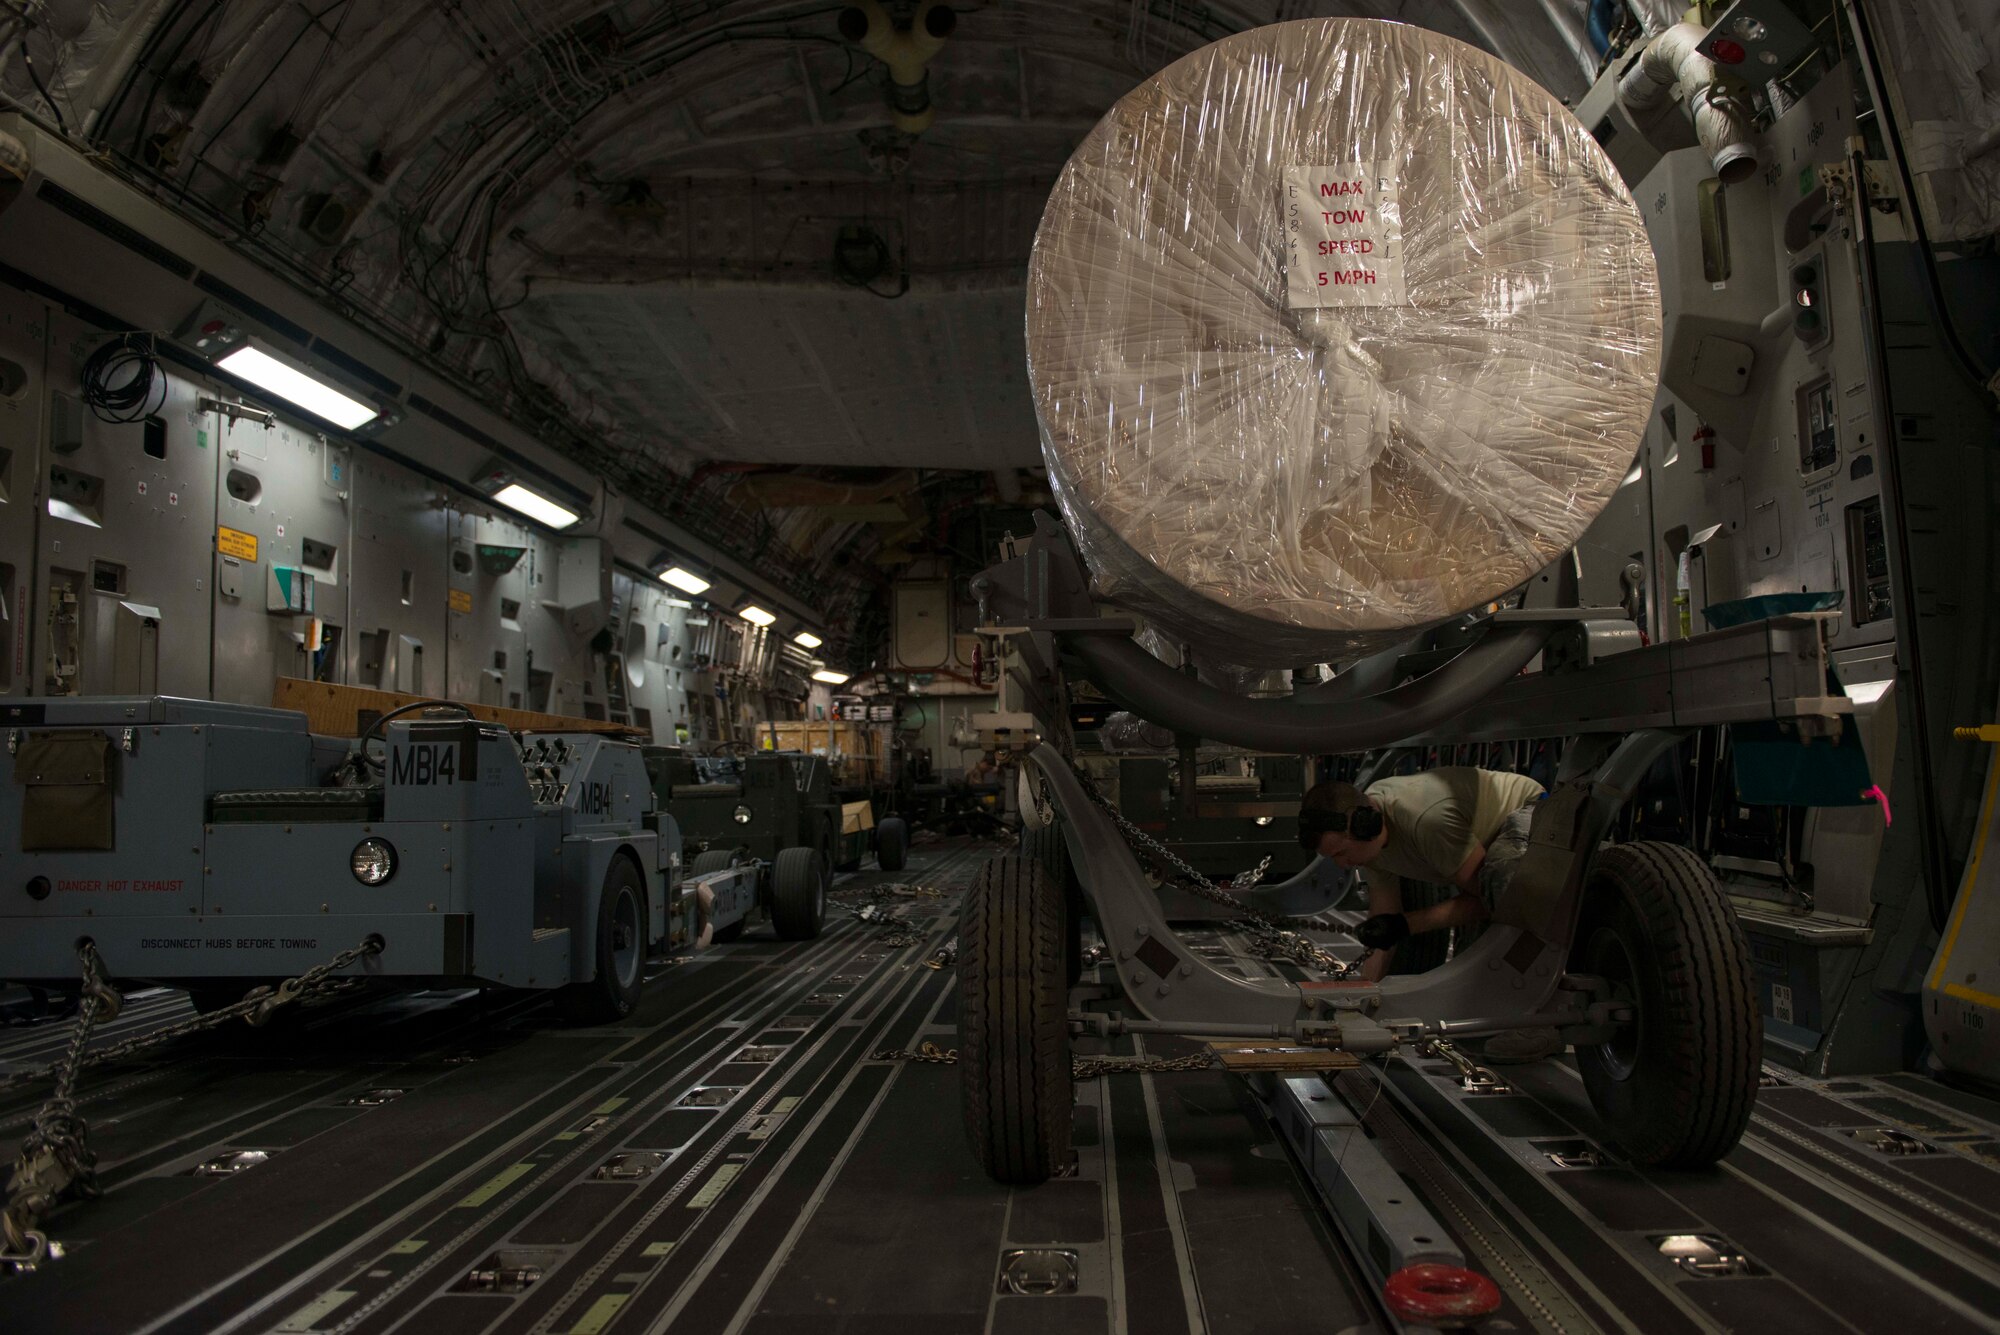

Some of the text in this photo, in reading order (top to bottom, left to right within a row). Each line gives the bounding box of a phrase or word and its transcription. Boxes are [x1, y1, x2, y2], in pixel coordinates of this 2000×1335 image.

[1321, 181, 1363, 197] MAX
[1321, 210, 1365, 225] TOW
[1318, 239, 1373, 255] SPEED
[1318, 270, 1376, 286] 5 MPH
[58, 880, 184, 892] DANGER HOT EXHAUST
[141, 938, 317, 949] DISCONNECT HUBS BEFORE TOWING
[1963, 1011, 1984, 1030] 1100
